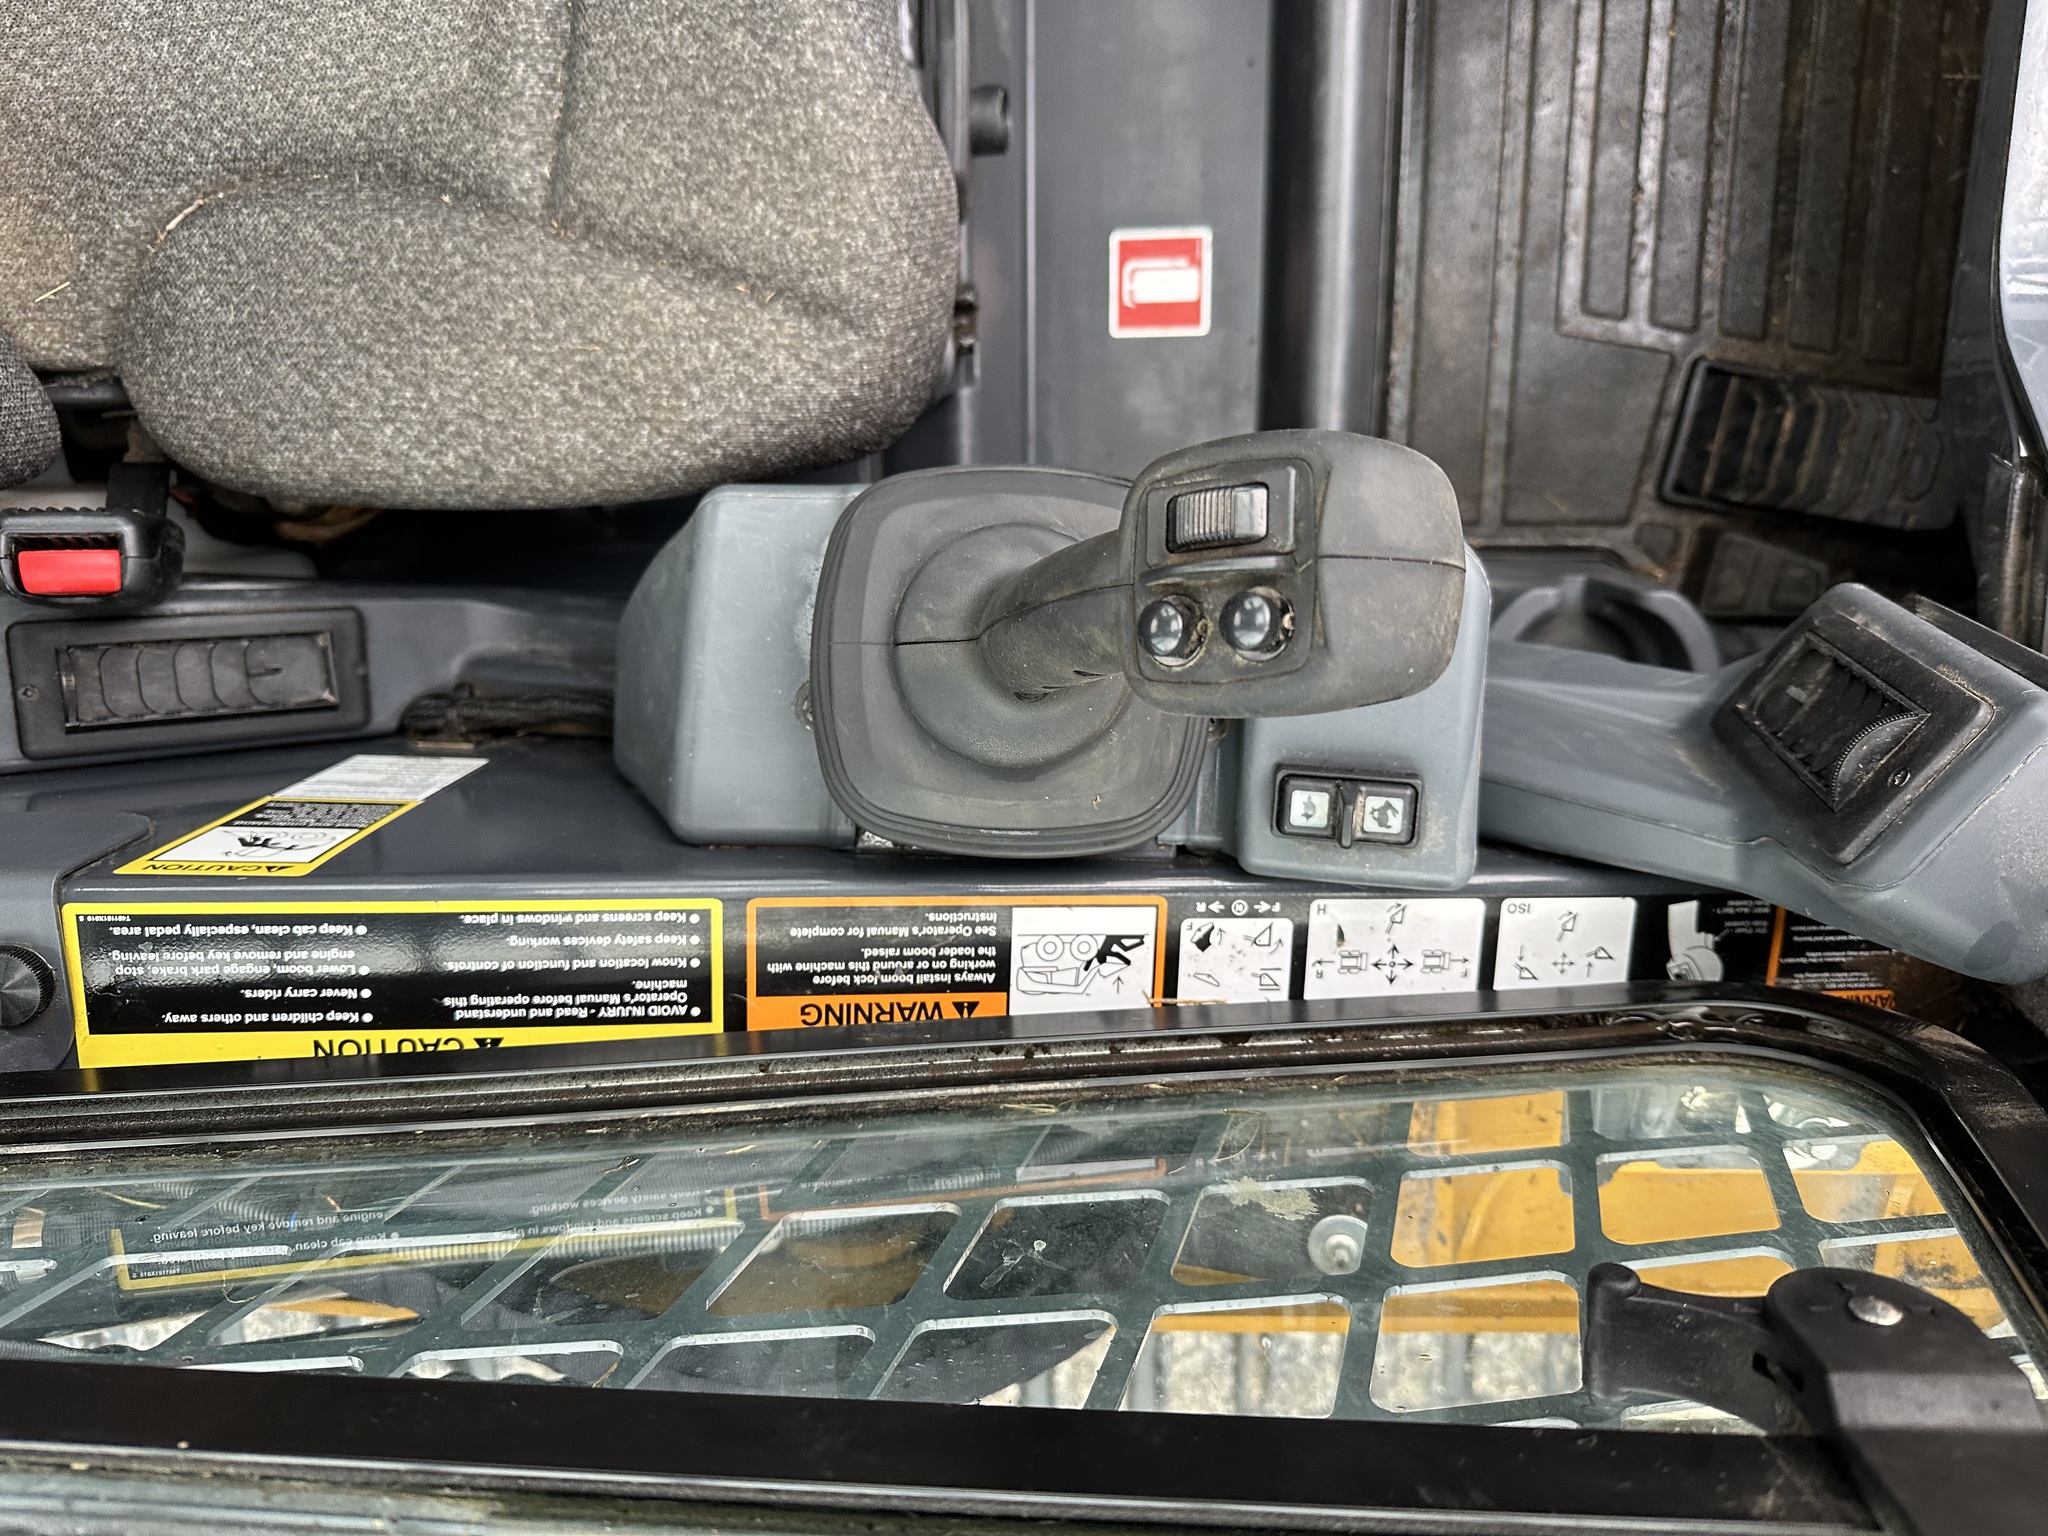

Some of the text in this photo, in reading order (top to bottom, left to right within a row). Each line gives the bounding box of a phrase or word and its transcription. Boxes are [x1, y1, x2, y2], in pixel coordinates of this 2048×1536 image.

[1317, 904, 1326, 915] H
[1507, 903, 1532, 914] ISO
[460, 911, 686, 925] Keep screens and windows in place.
[926, 912, 996, 923] instructions.
[109, 923, 353, 937] Keep cab clean, especially pedal area.
[790, 923, 996, 938] See Operator's Manual for complete
[506, 932, 686, 947] Keep safety devices working.
[109, 948, 355, 963] engine and remove key before leaving.
[861, 947, 996, 959] the loader boom raised.
[116, 963, 356, 977] Lower boom, engage park brake, stop
[444, 957, 686, 972] Know location and function of controls.
[768, 957, 995, 973] working on or around this machine with
[631, 980, 687, 990] machine.
[813, 972, 995, 986] Always install boom lock before
[241, 987, 357, 1000] Never carry riders.
[444, 991, 687, 1008] Operator's Manual before operating this
[455, 1008, 526, 1020] understand
[530, 1007, 553, 1018] and
[557, 1007, 588, 1018] Read
[599, 1005, 645, 1017] INJURY
[648, 1005, 687, 1015] AVOID
[800, 1002, 943, 1026] WARNING
[162, 1010, 359, 1025] Keep children and others away.
[314, 1038, 464, 1057] CAUTION
